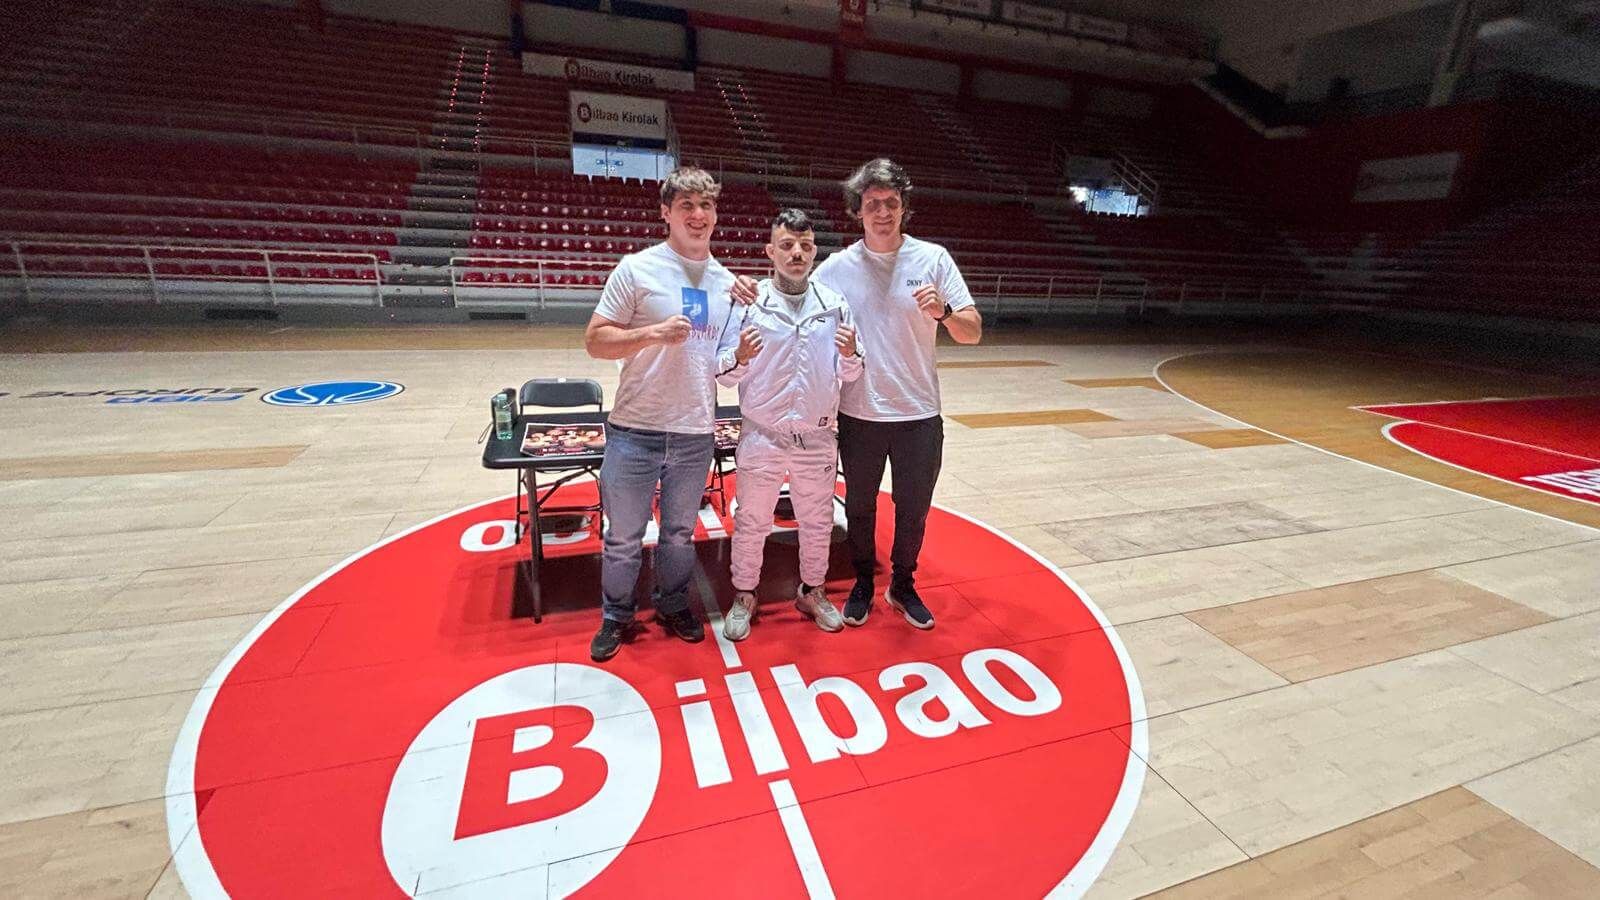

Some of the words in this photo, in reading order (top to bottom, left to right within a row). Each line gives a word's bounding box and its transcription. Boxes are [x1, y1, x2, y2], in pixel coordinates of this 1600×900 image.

[564, 58, 611, 80] Bilbao
[614, 70, 656, 86] Kirolak
[577, 103, 619, 123] Bilbao
[621, 111, 659, 126] Kirolak
[906, 279, 922, 287] DKNY
[19, 387, 259, 399] EUROPE
[454, 647, 1063, 841] Bilbao
